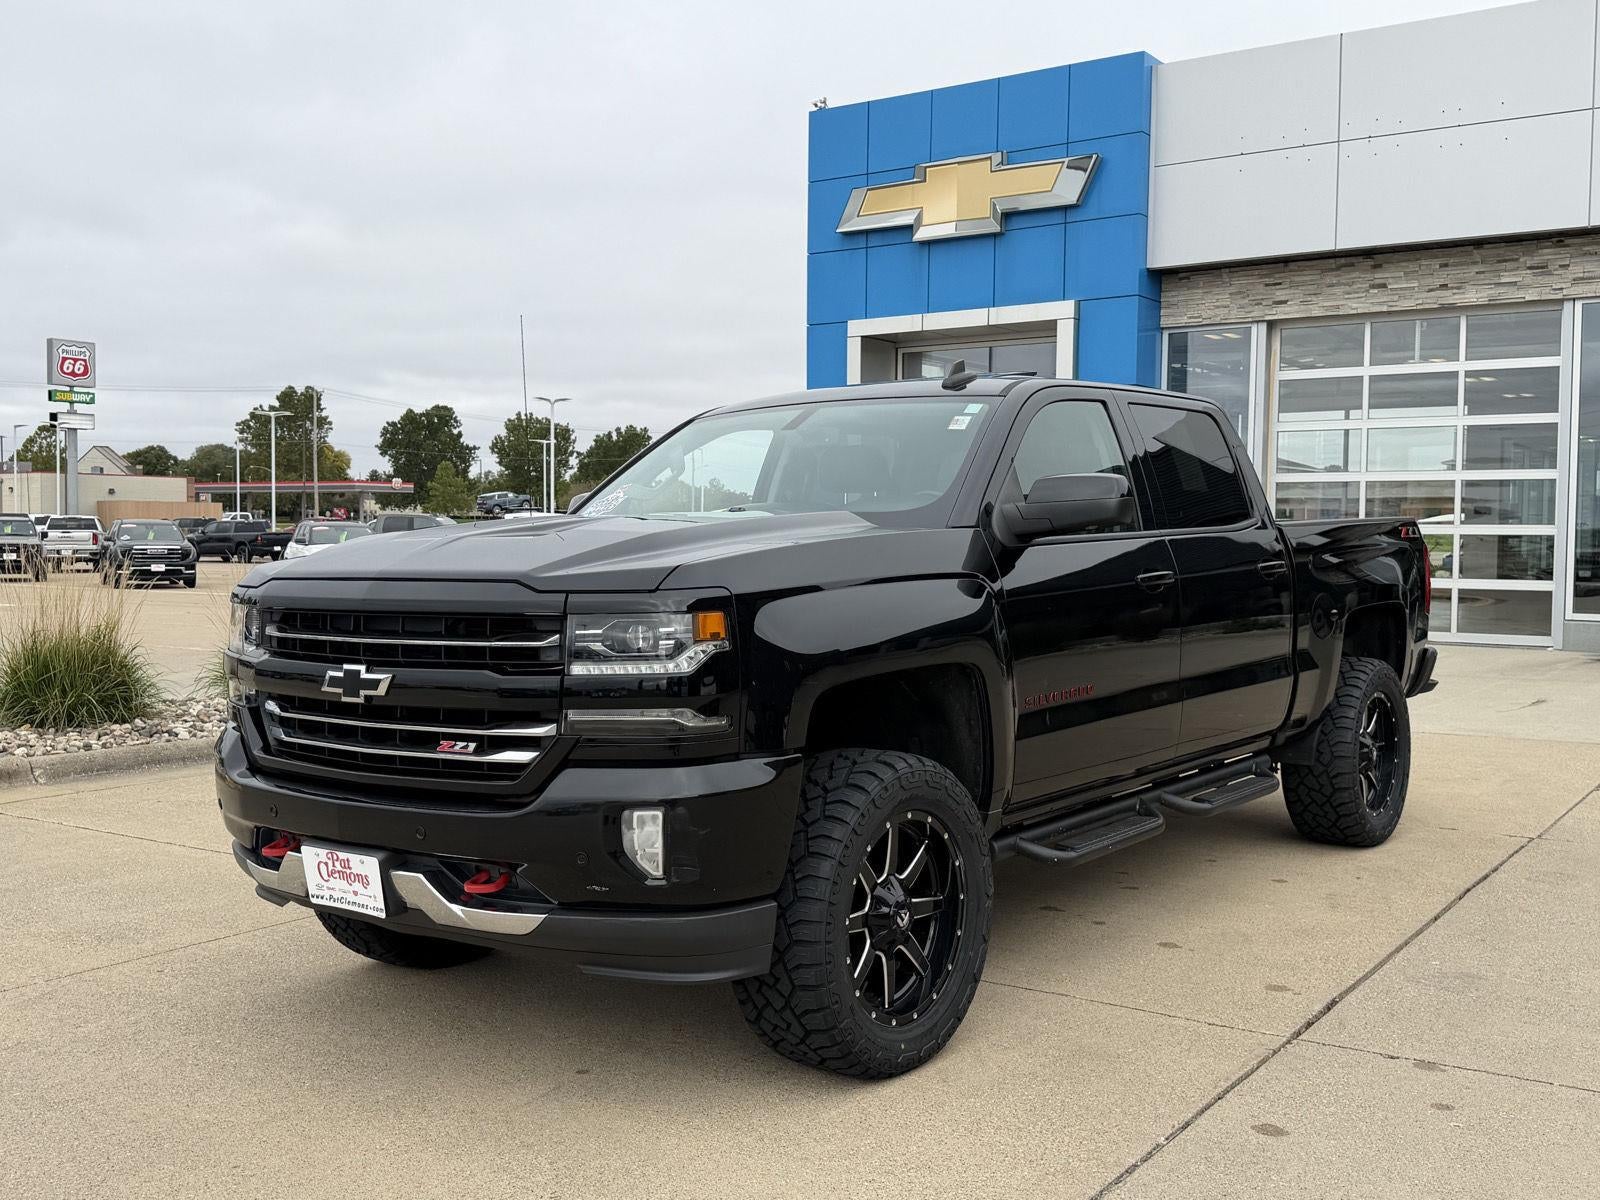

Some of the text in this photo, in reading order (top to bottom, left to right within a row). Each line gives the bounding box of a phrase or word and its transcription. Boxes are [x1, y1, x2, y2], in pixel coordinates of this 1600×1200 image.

[61, 348, 88, 358] PHILLIPS
[63, 359, 85, 374] 66
[56, 392, 93, 402] SUBWAY
[436, 740, 477, 754] Z71
[326, 851, 353, 871] Pat
[317, 860, 371, 890] Clemons
[310, 892, 384, 914] www.PatClemons.com
